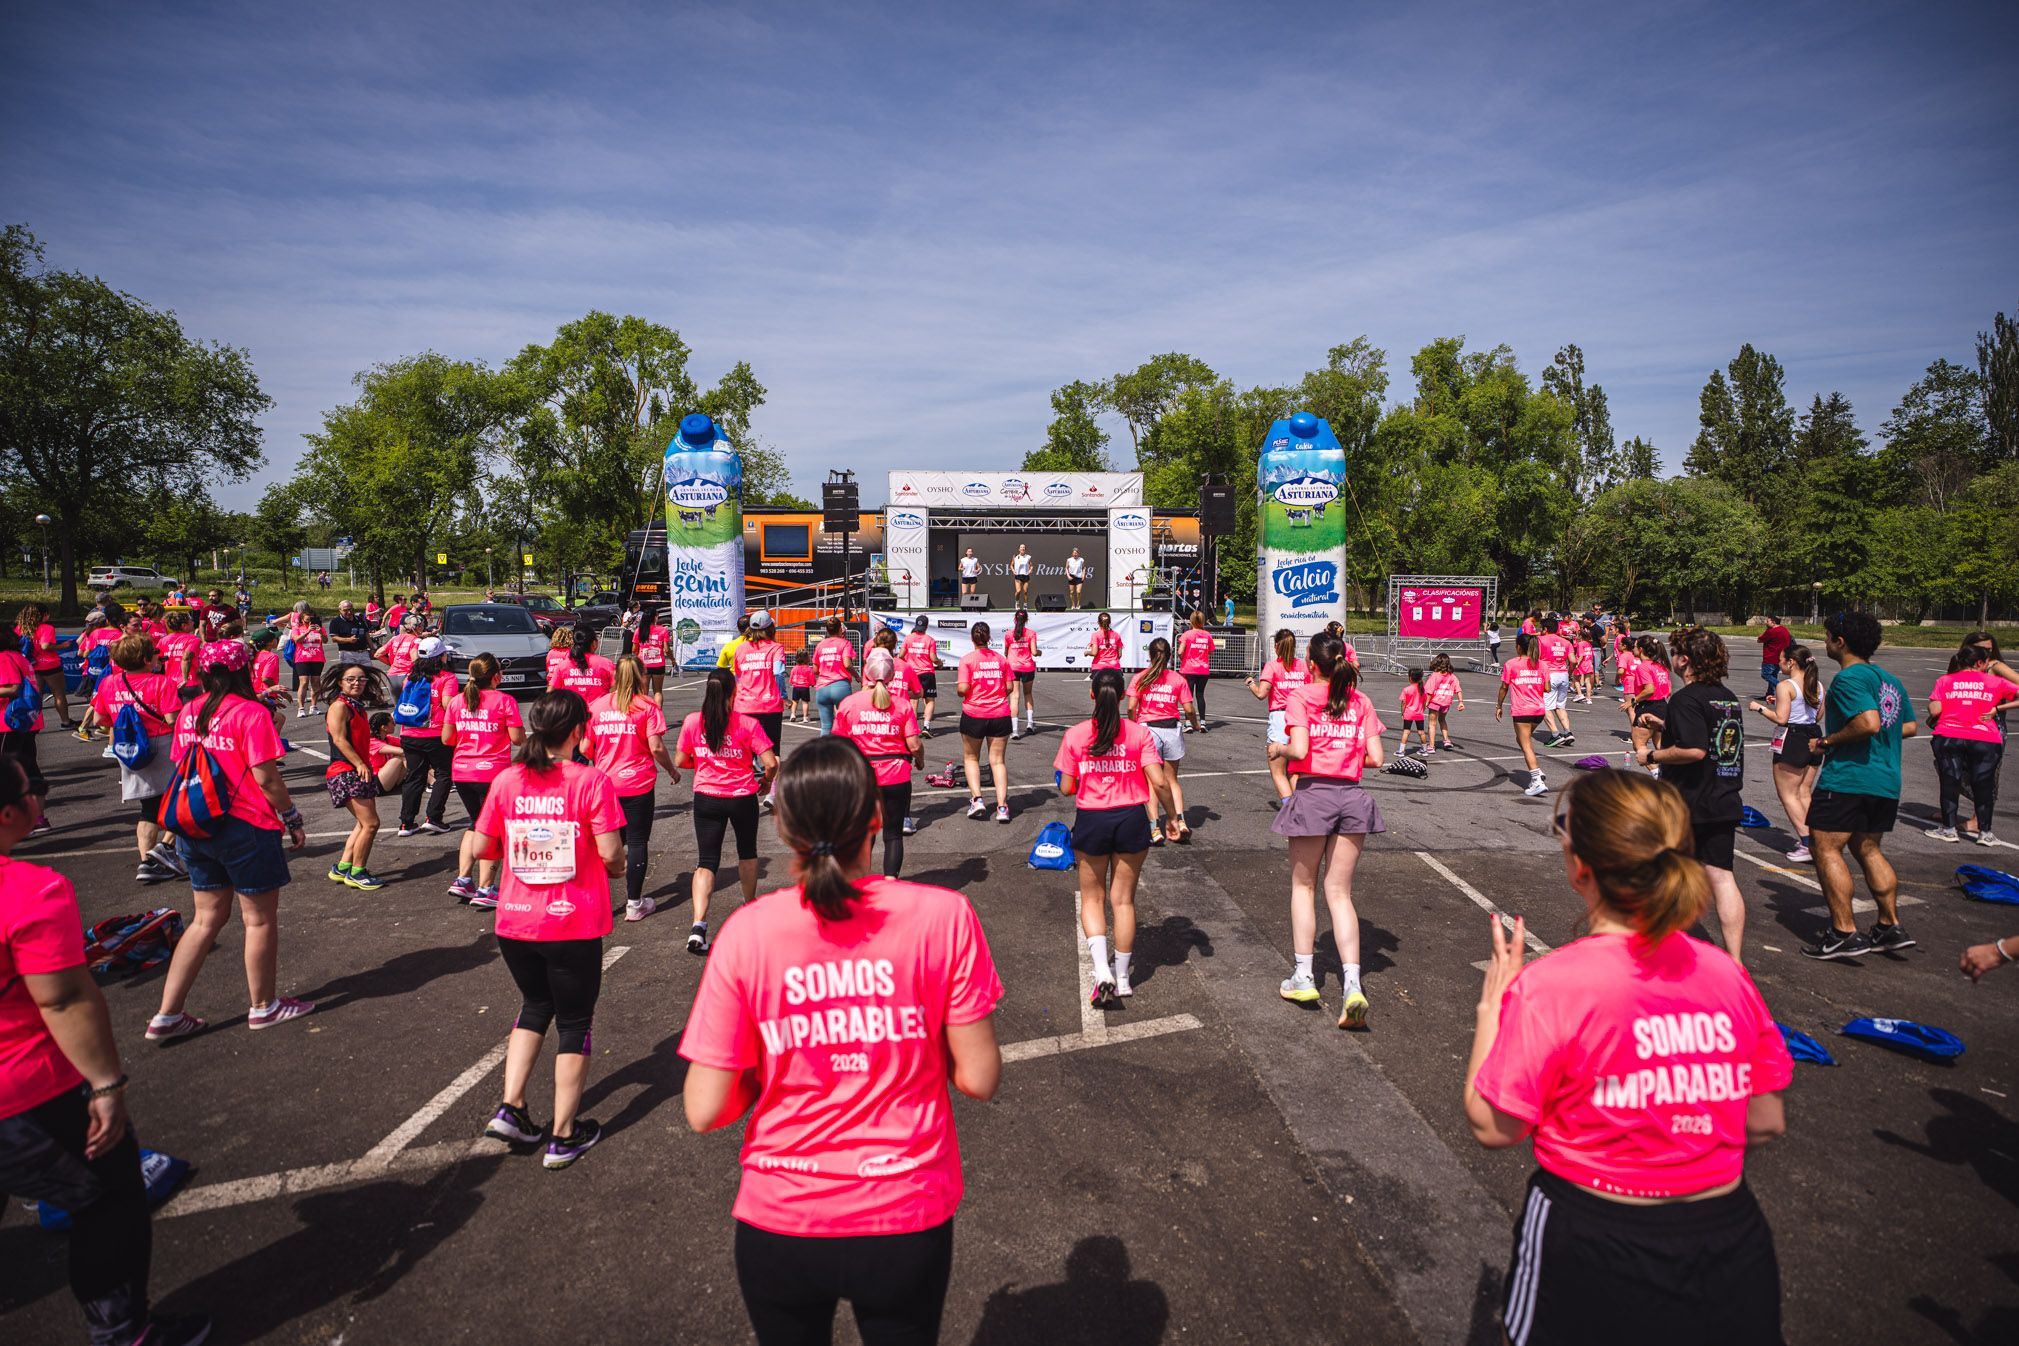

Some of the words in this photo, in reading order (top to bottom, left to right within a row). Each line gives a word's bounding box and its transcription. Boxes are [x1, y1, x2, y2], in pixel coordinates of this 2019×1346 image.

[672, 489, 724, 501] ASTURIANA
[1278, 488, 1334, 500] ASTURIANA
[891, 546, 922, 554] OYSHO
[1114, 547, 1146, 555] OYSHO
[675, 558, 704, 575] Leche
[674, 571, 731, 594] semi
[1278, 567, 1331, 594] Calcio
[675, 593, 732, 609] desnatada
[1301, 592, 1329, 605] natural
[1953, 681, 1984, 691] SOMOS
[859, 710, 891, 723] SOMOS
[515, 796, 565, 816] SOMOS
[529, 850, 553, 861] 016
[504, 903, 532, 913] OYSHO
[784, 958, 895, 1006] SOMOS
[1632, 1011, 1737, 1060] SOMOS
[830, 1052, 869, 1073] 2026
[1590, 1062, 1754, 1110] IMPARABLE
[1671, 1113, 1714, 1136] 2026
